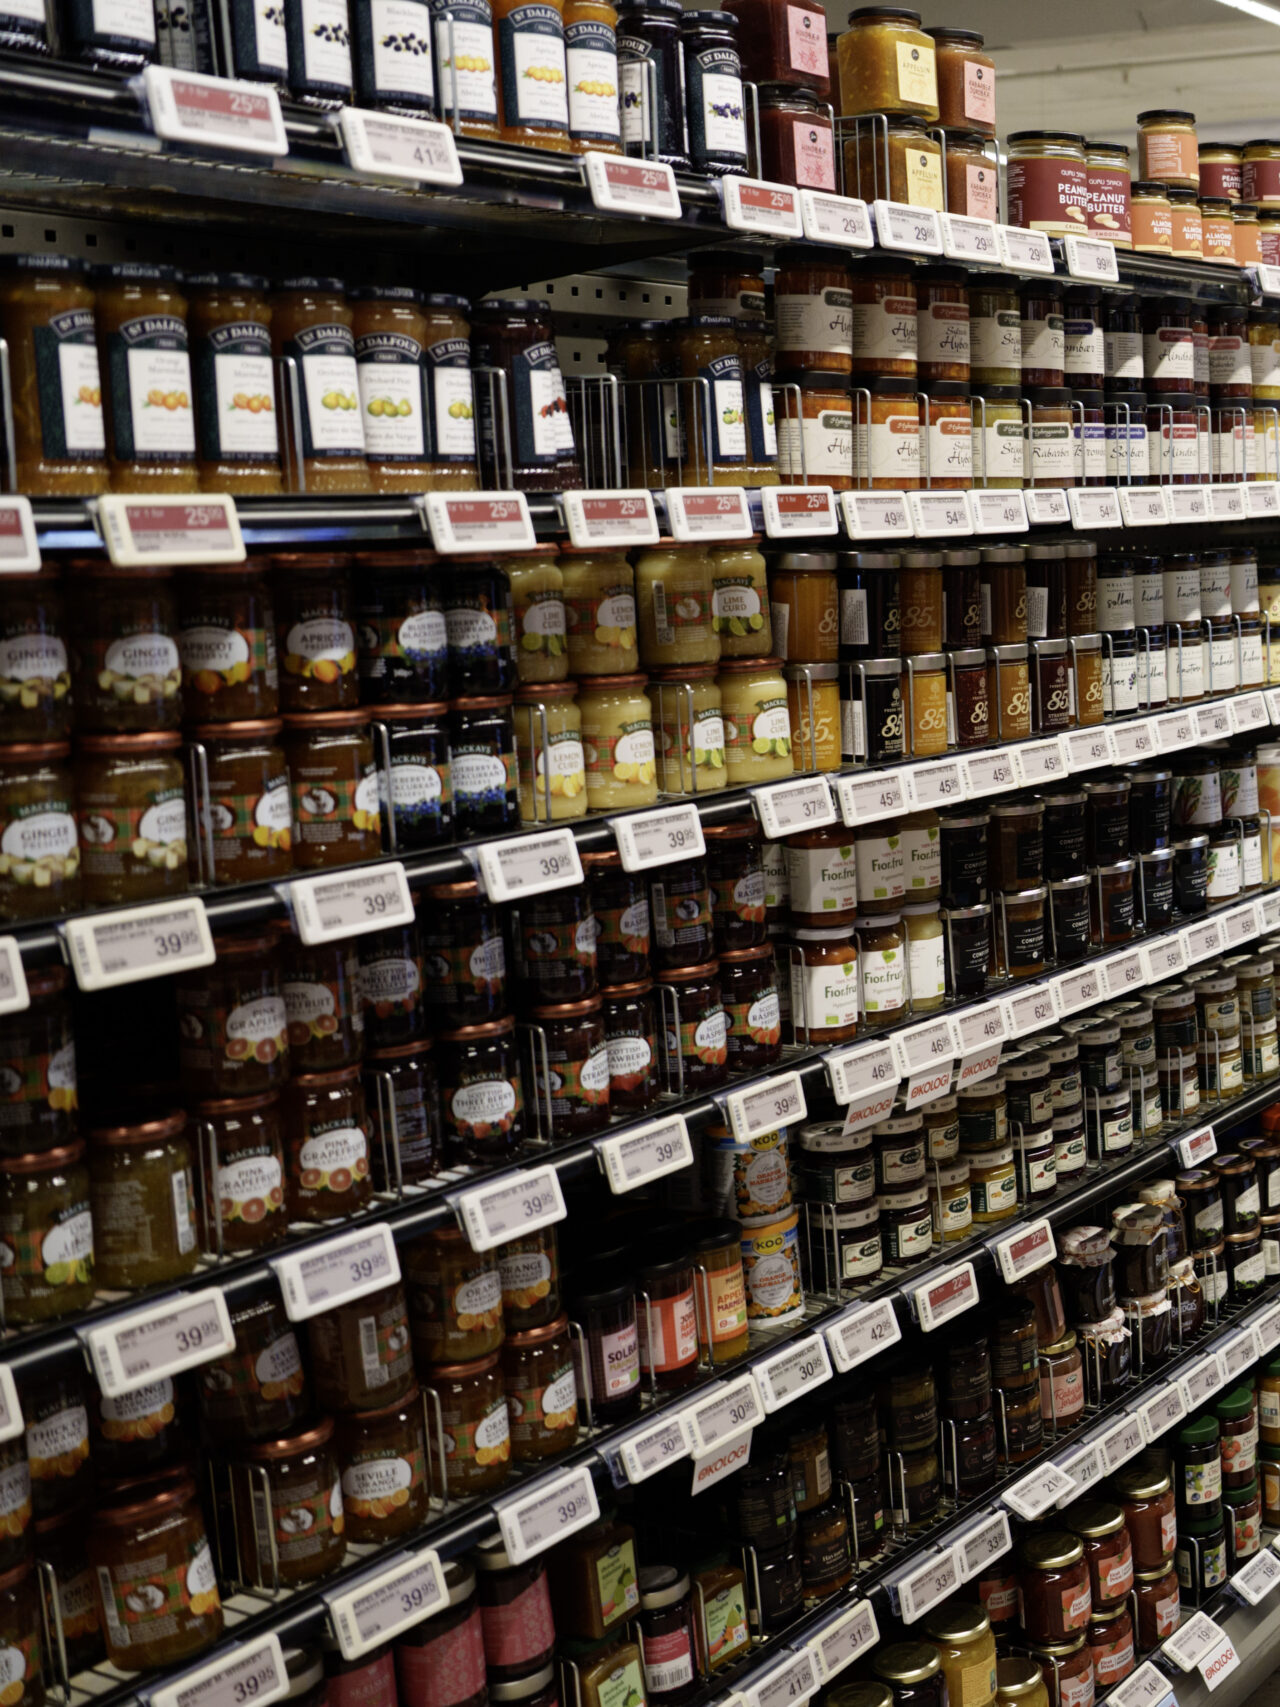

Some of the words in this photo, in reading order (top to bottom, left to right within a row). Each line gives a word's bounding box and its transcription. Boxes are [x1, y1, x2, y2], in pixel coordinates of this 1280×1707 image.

[527, 9, 562, 23] DALFOU
[580, 26, 616, 42] DALFOU
[1058, 183, 1087, 197] PEANU
[1059, 195, 1087, 207] BUTTE
[1086, 192, 1125, 205] PEANUT
[1087, 203, 1125, 215] BUTTER
[1206, 233, 1232, 242] ALMOND
[1208, 239, 1231, 247] BUTTER
[366, 334, 420, 355] DALFOUR
[723, 596, 746, 605] LIME
[722, 603, 748, 613] CURD
[961, 1055, 999, 1079] ØKOLOGI
[911, 1073, 951, 1099] ØKOLOGI
[756, 1237, 784, 1251] KOO
[354, 1467, 399, 1483] SEVILLE
[1204, 1647, 1236, 1681] ØKOLOGI
